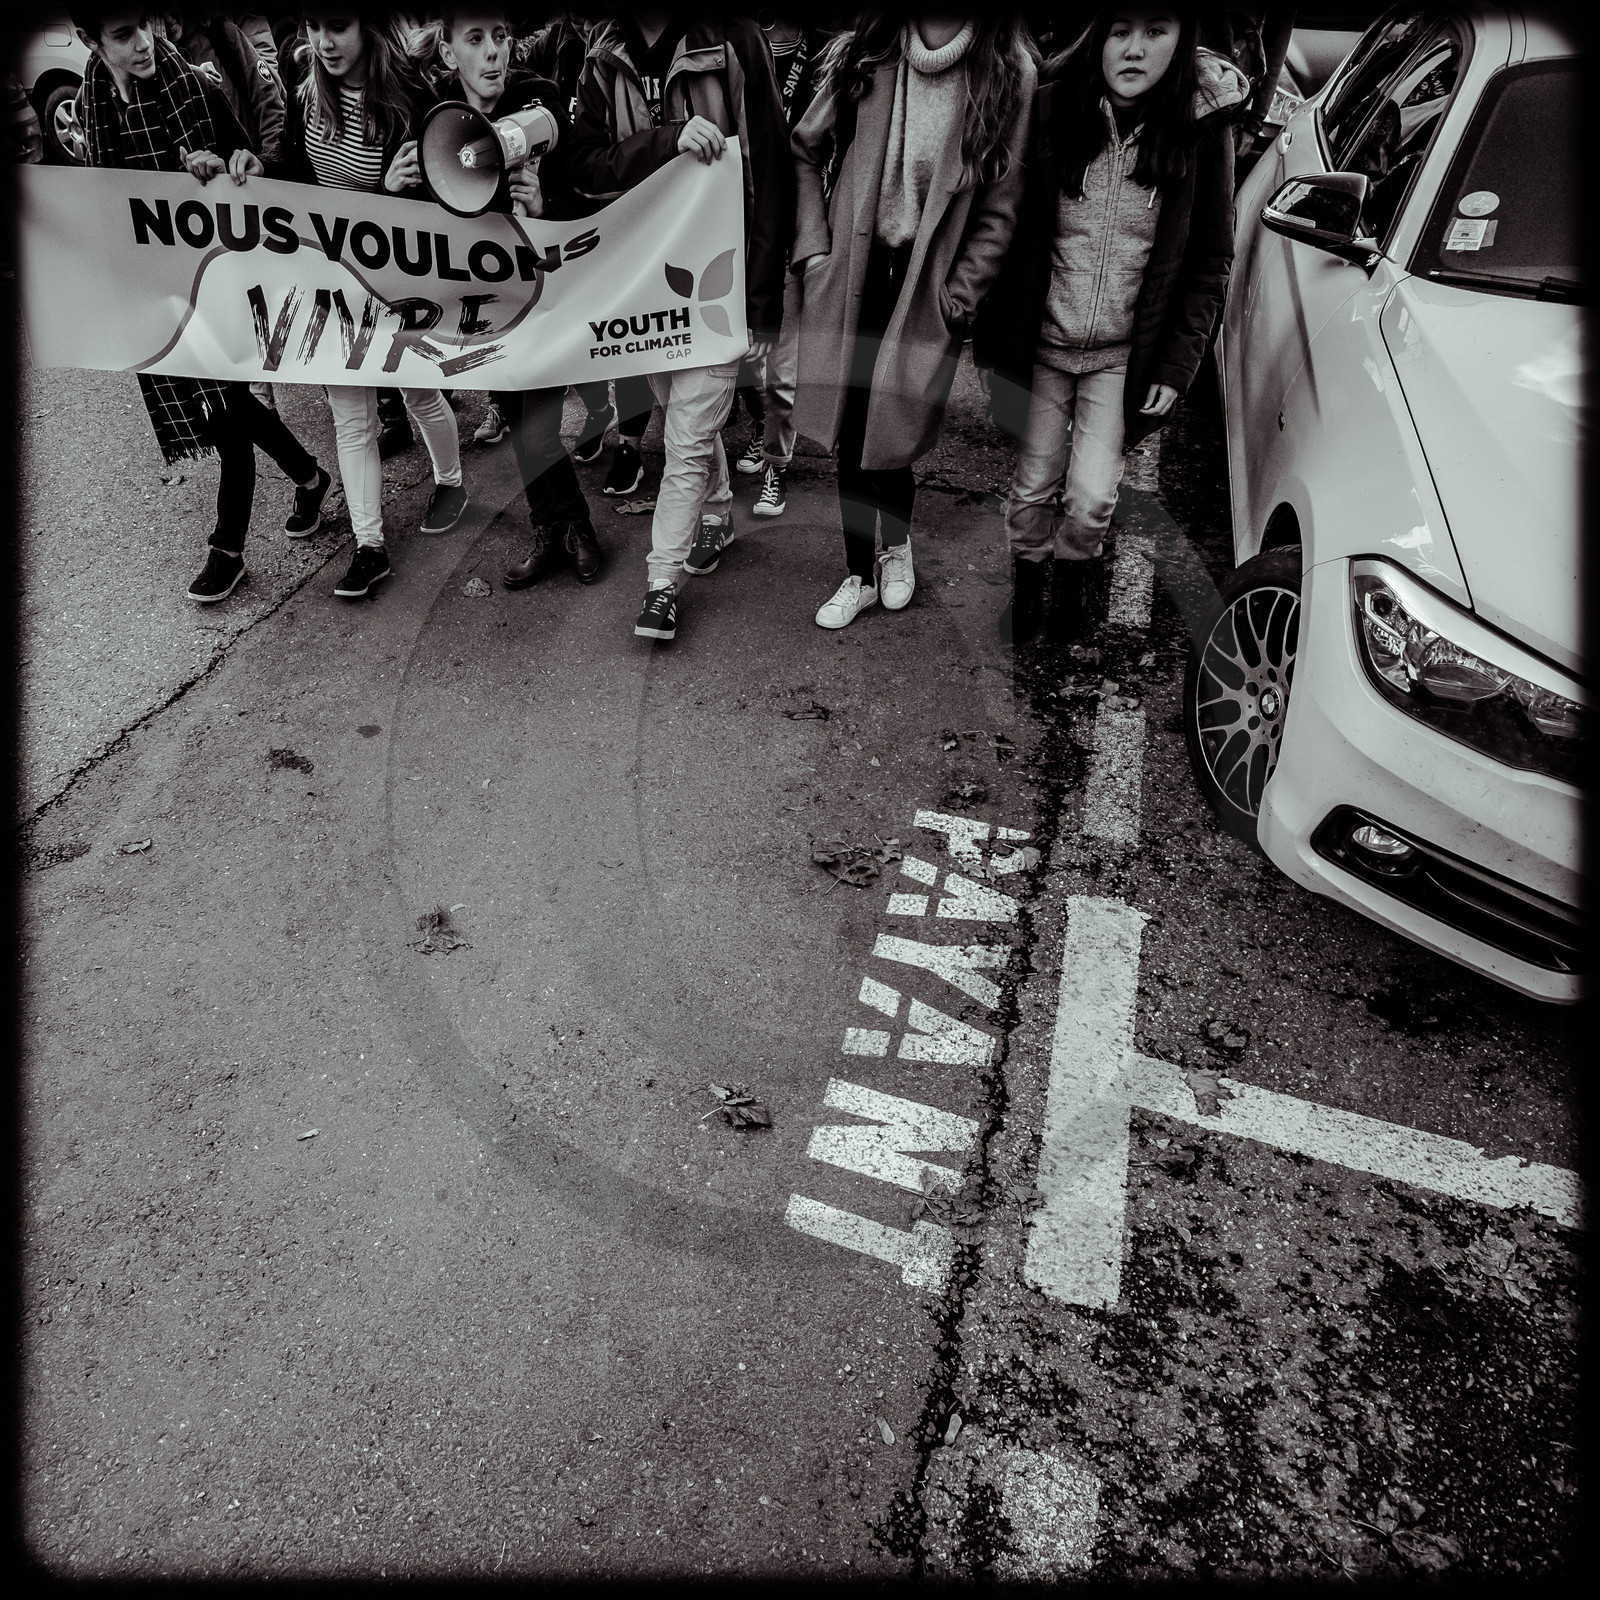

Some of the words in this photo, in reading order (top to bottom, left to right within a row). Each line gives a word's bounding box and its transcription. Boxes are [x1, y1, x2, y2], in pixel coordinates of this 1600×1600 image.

[782, 61, 804, 98] SAVE
[129, 197, 300, 254] NOUS
[309, 212, 600, 284] VOULONS
[246, 283, 508, 378] VIVRE
[588, 306, 691, 343] YOUTH
[589, 344, 622, 359] FOR
[625, 332, 692, 354] CLIMATE
[666, 348, 692, 360] GAP
[783, 808, 1032, 1295] PAYANT
